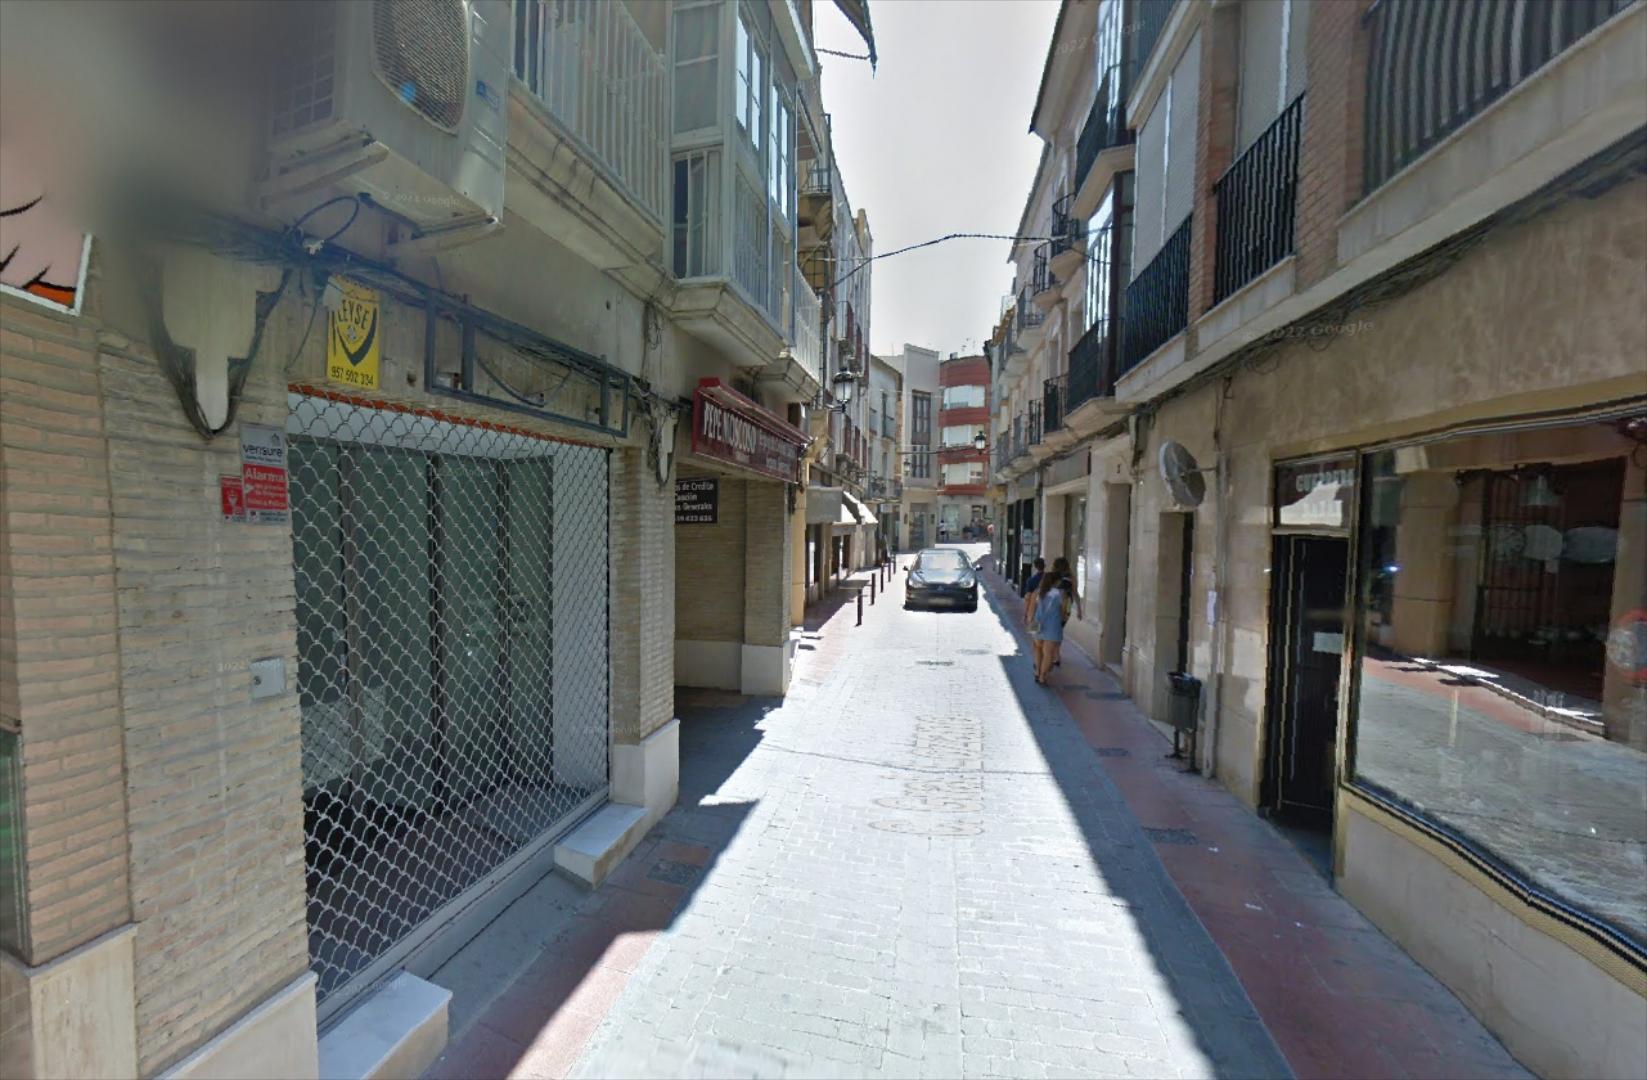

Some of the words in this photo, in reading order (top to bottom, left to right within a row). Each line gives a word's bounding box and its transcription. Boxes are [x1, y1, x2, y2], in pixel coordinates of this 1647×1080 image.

[331, 366, 344, 381] 957
[704, 401, 722, 440] PEPE
[242, 444, 283, 458] verisure
